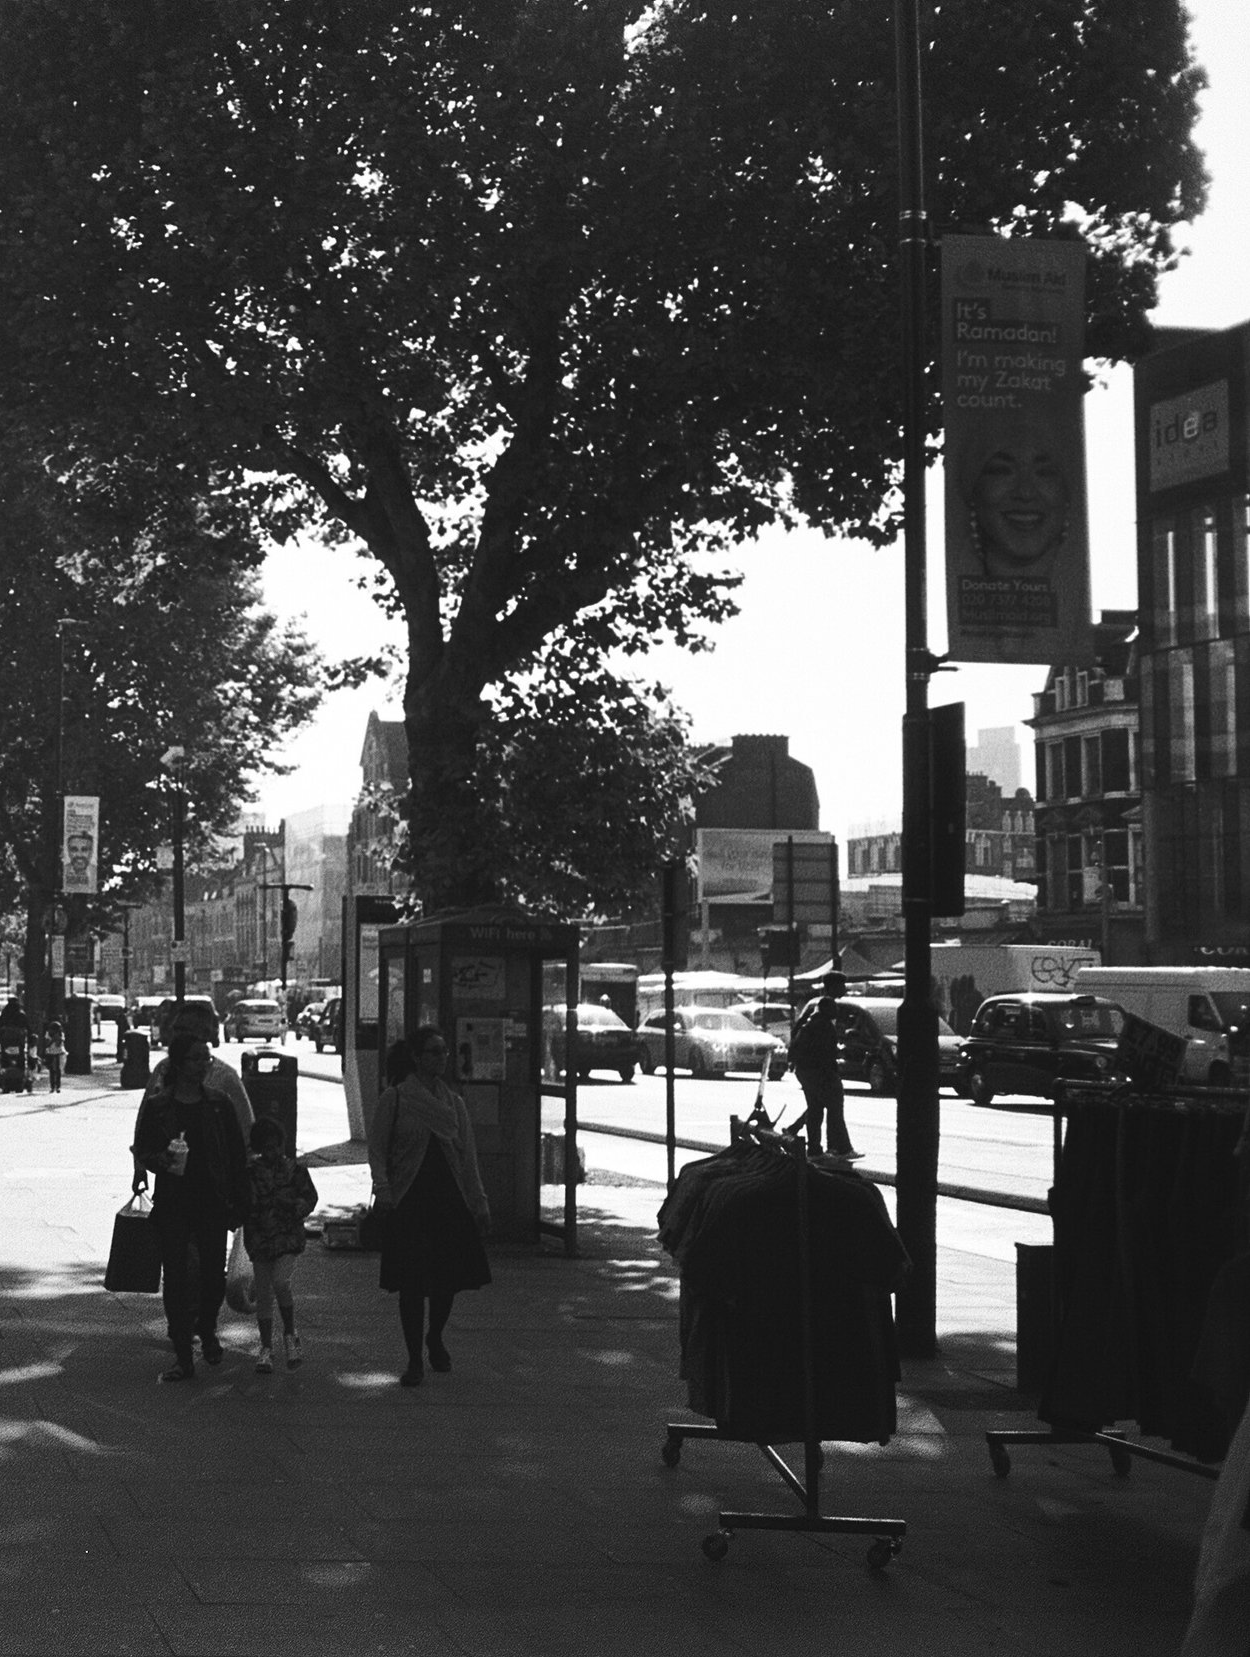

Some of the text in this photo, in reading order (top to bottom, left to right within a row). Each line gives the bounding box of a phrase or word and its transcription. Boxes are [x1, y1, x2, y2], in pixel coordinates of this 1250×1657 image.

[956, 321, 1058, 344] Ramadan!
[993, 351, 1067, 378] making
[956, 370, 1053, 393] my Zakat
[956, 393, 1024, 409] count.
[1156, 411, 1217, 449] idea
[961, 578, 1011, 592] Donate
[505, 926, 536, 940] here
